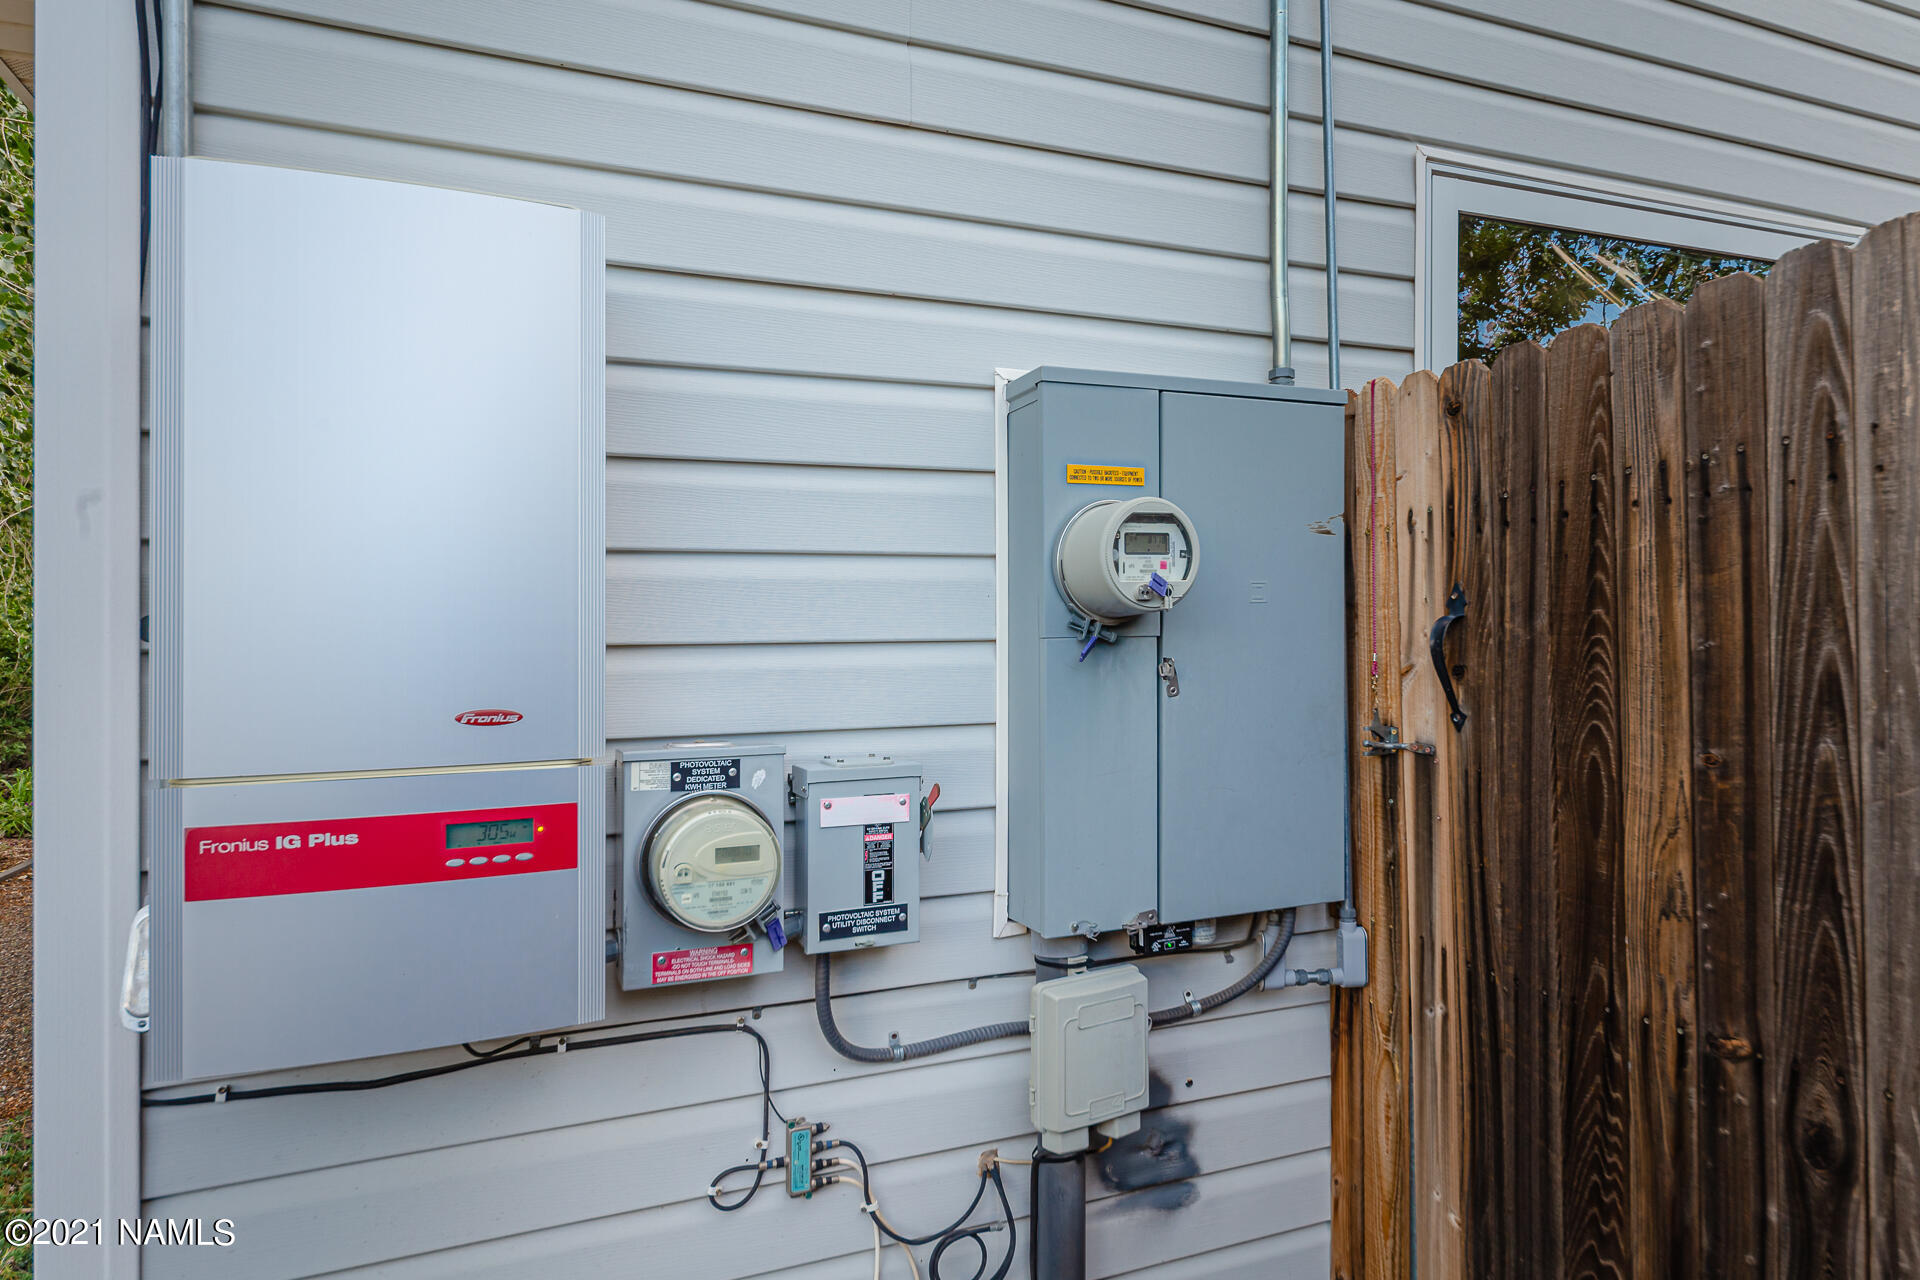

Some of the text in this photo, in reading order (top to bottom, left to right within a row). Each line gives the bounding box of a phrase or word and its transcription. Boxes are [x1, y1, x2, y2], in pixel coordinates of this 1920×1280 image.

[460, 713, 520, 724] Fronius
[680, 760, 732, 768] PHOTOVOLTAIC
[686, 775, 726, 783] DEDICATED
[703, 782, 727, 790] METER
[199, 833, 359, 855] Fronius IG Plus
[872, 870, 885, 903] OFF
[828, 908, 900, 922] PHOTOVOLTAIC SYSTEM
[832, 915, 896, 929] UTILITY DISCONNECT
[852, 925, 876, 933] SWITCH
[690, 947, 718, 957] WARNING
